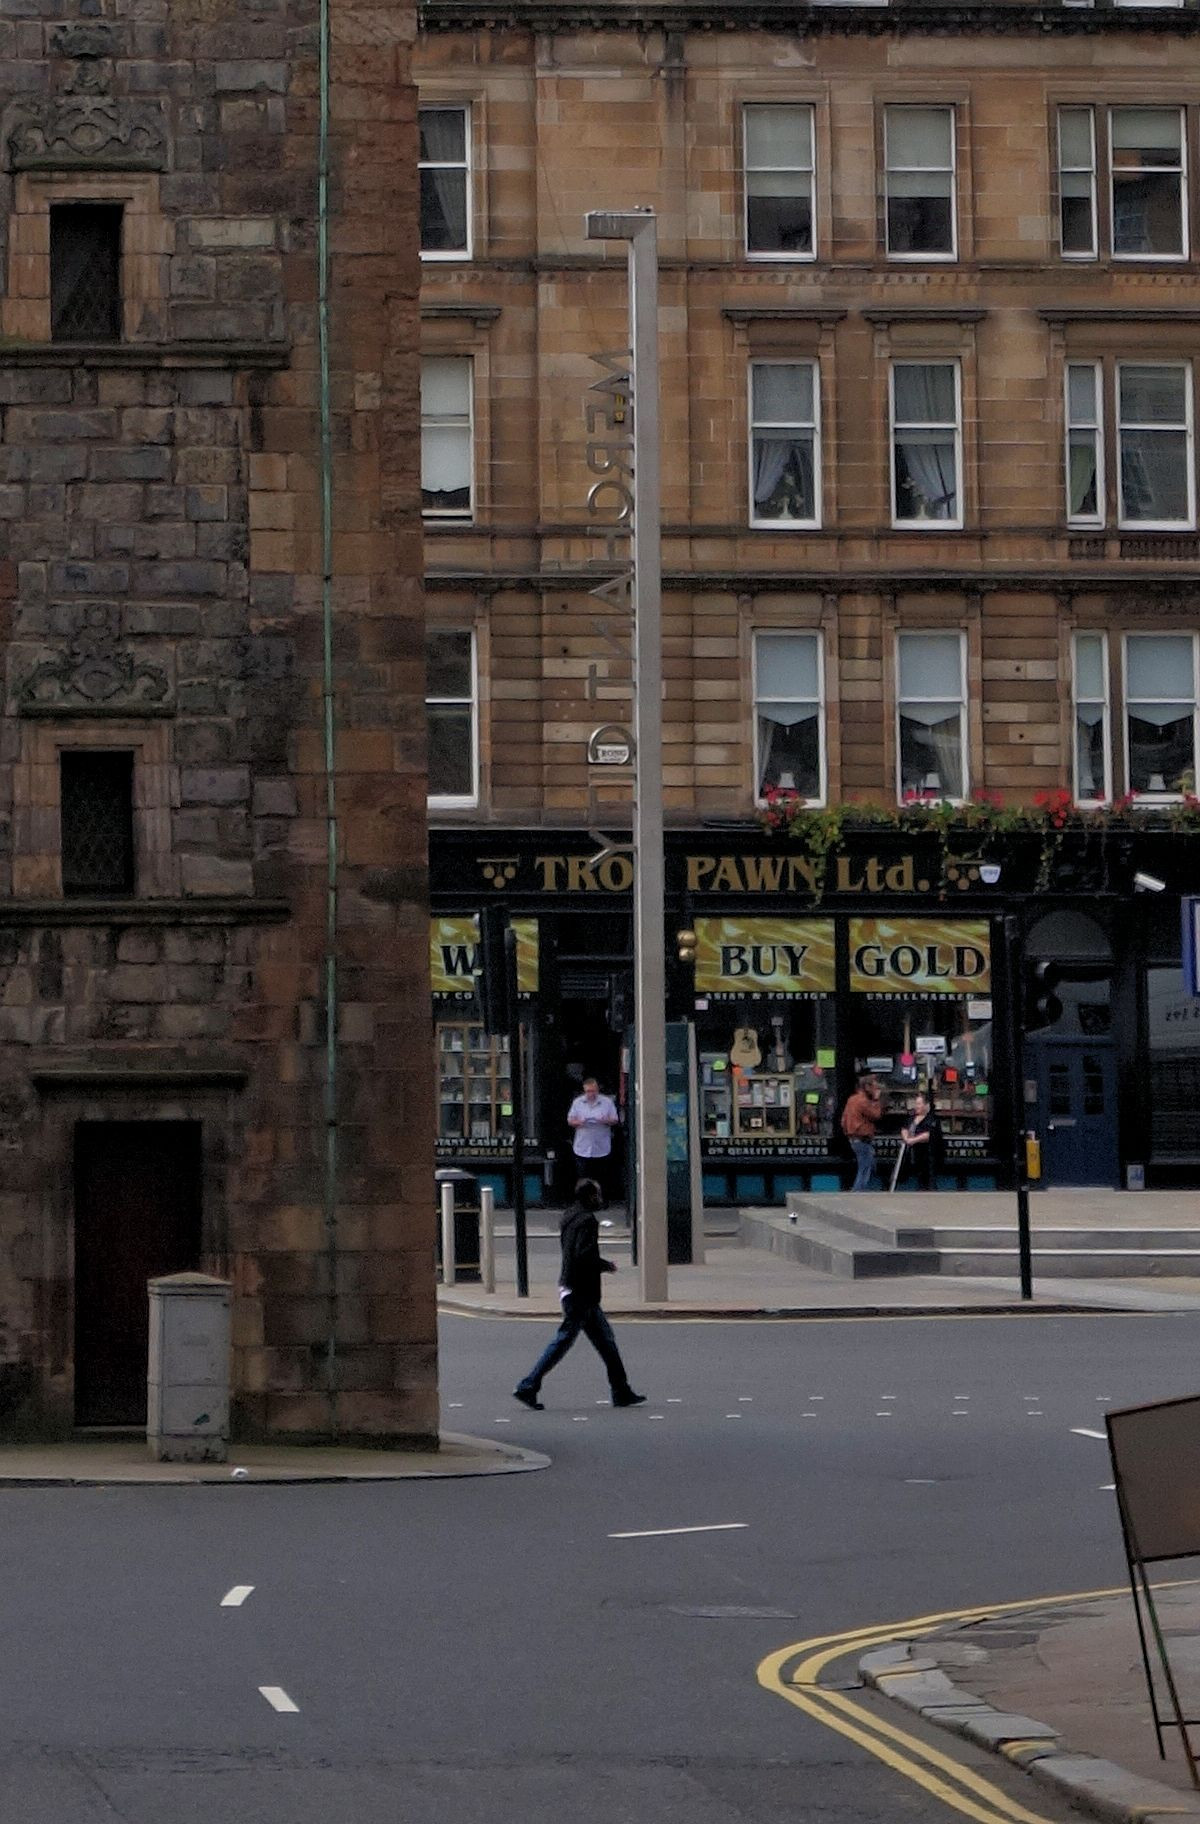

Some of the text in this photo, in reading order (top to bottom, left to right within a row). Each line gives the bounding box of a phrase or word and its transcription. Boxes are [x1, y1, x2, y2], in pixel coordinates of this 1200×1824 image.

[535, 856, 930, 892] TRO PAWN Ltd.
[719, 945, 809, 977] BUY
[854, 945, 987, 978] GOLD
